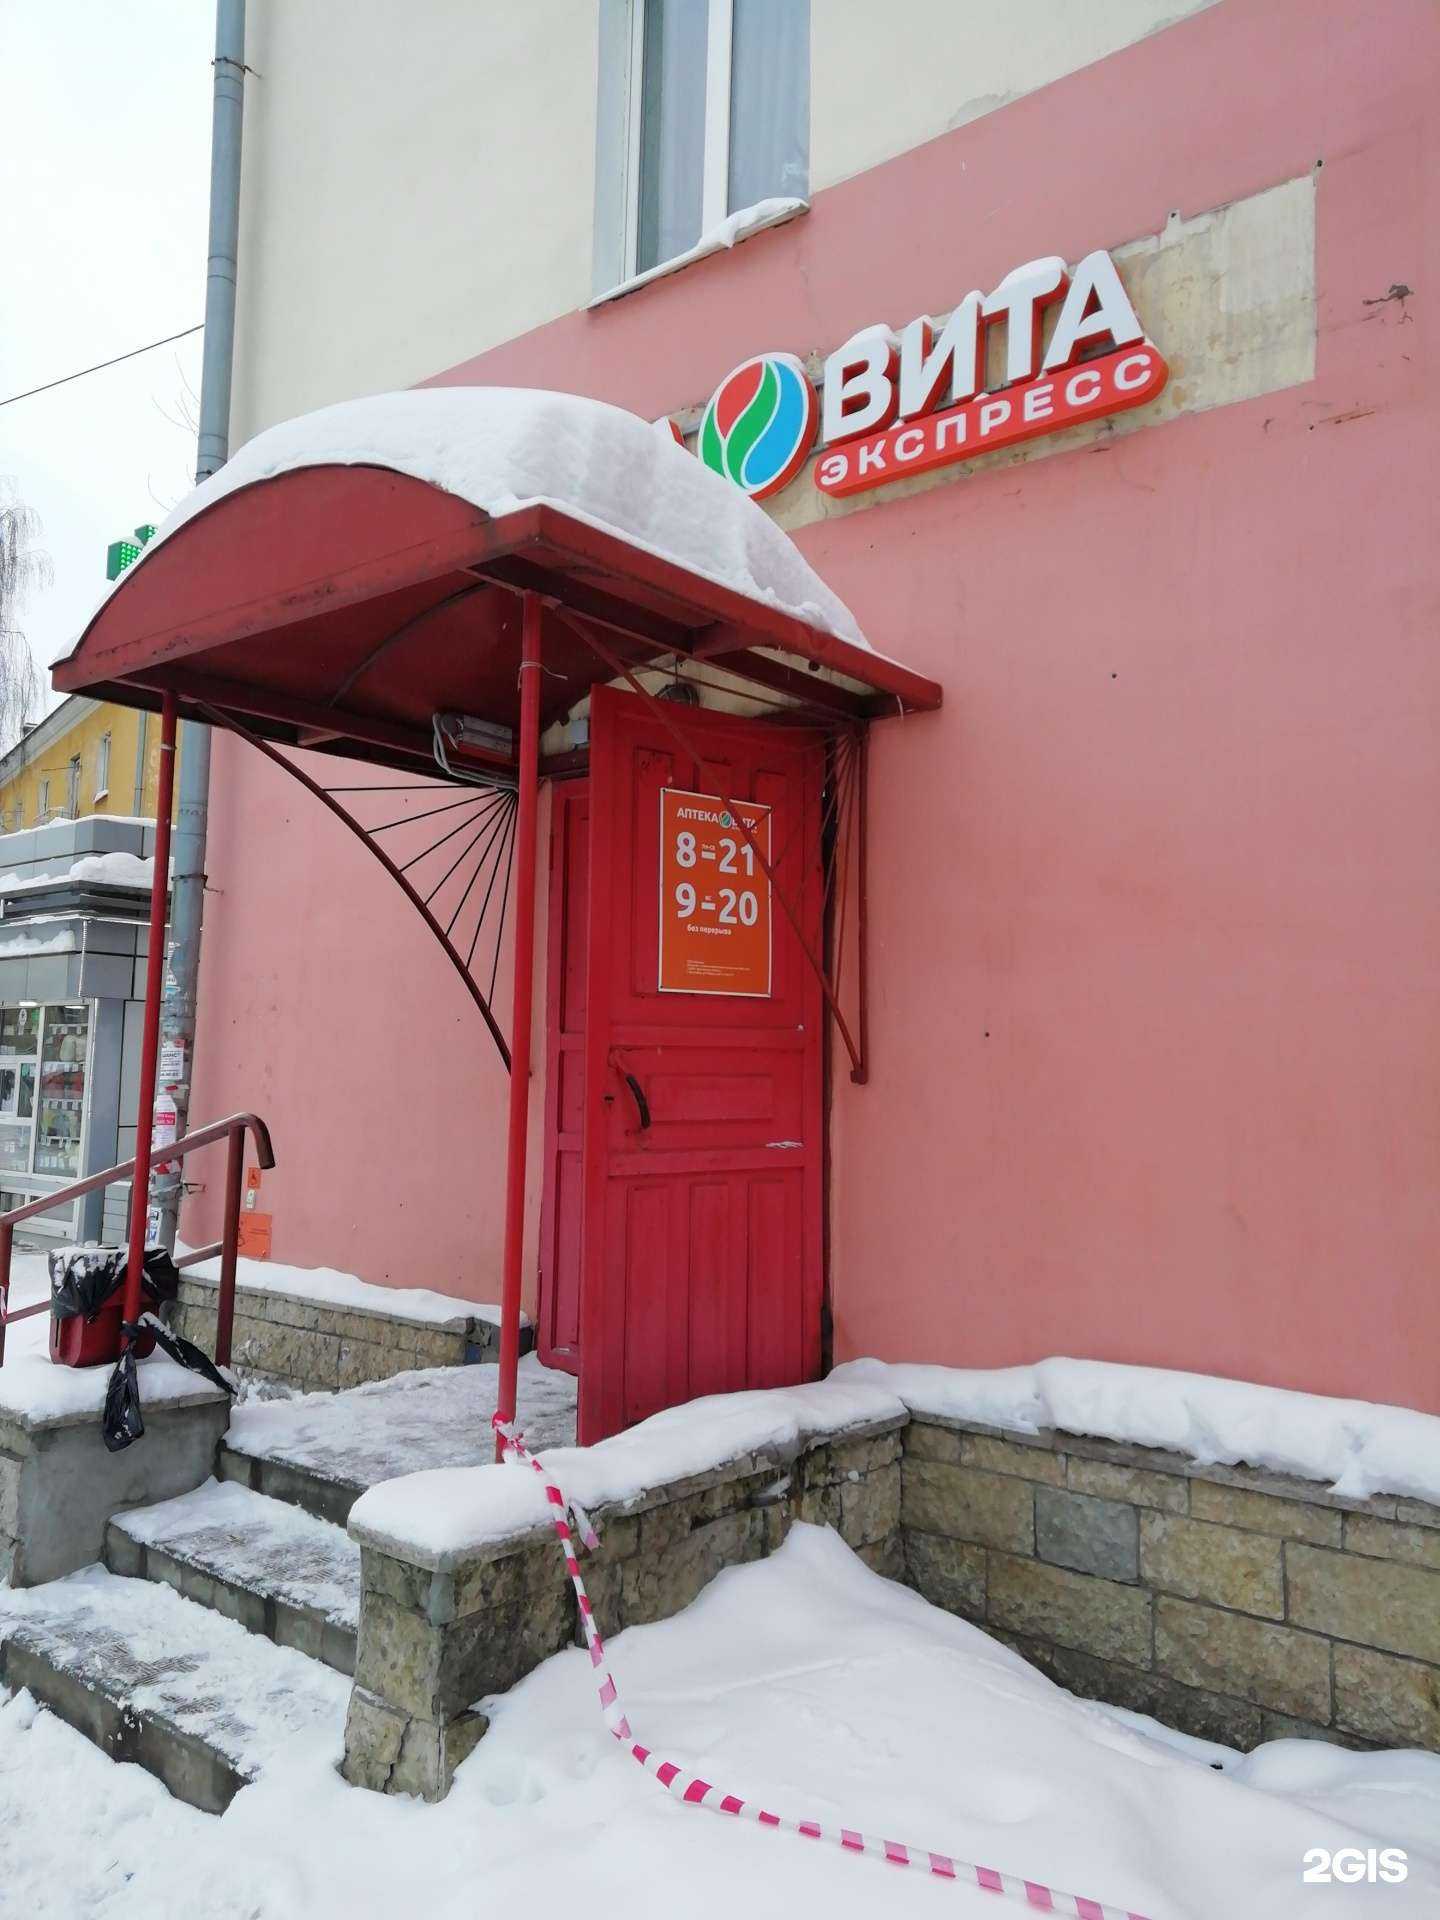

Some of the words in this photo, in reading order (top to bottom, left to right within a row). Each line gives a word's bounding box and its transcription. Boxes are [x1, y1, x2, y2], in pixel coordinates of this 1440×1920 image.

[822, 250, 1145, 444] ВИТА
[819, 353, 1153, 487] ЭКСПРЕСС
[676, 807, 719, 824] АПТЕКА
